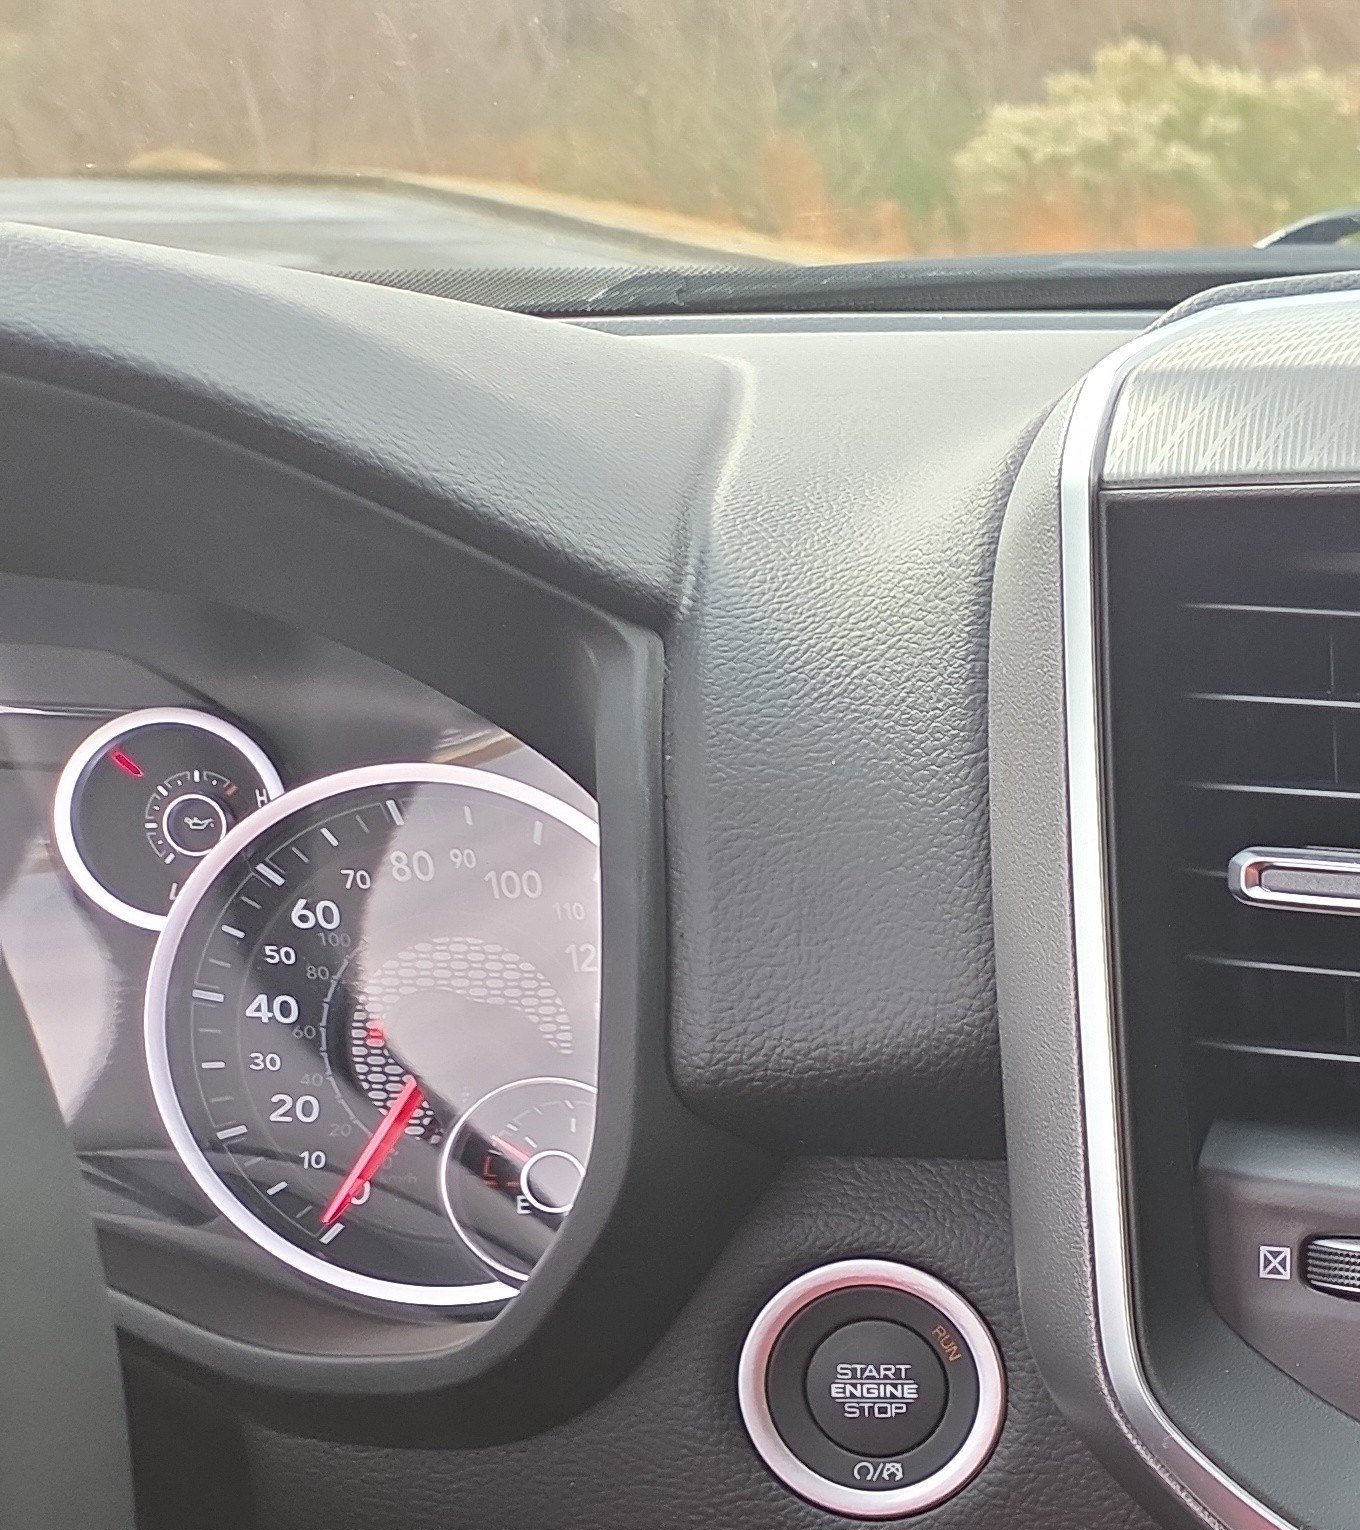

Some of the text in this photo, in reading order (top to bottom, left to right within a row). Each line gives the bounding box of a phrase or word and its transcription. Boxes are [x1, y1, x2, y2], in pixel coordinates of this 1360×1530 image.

[389, 850, 435, 882] 80
[449, 849, 477, 869] 90
[340, 869, 371, 889] 70
[483, 870, 543, 899] 100
[291, 898, 341, 929] 60
[552, 902, 585, 920] 110
[317, 932, 351, 947] 100
[264, 945, 296, 965] 50
[306, 966, 330, 980] 80
[245, 994, 299, 1024] 40
[292, 1025, 316, 1039] 60
[249, 1052, 282, 1071] 30
[300, 1073, 324, 1087] 40
[269, 1094, 320, 1123] 20
[299, 1151, 326, 1169] 10
[517, 1195, 531, 1214] E
[932, 1325, 962, 1362] RUN
[836, 1364, 912, 1379] START
[830, 1384, 918, 1398] ENGINE
[844, 1402, 907, 1418] STOP
